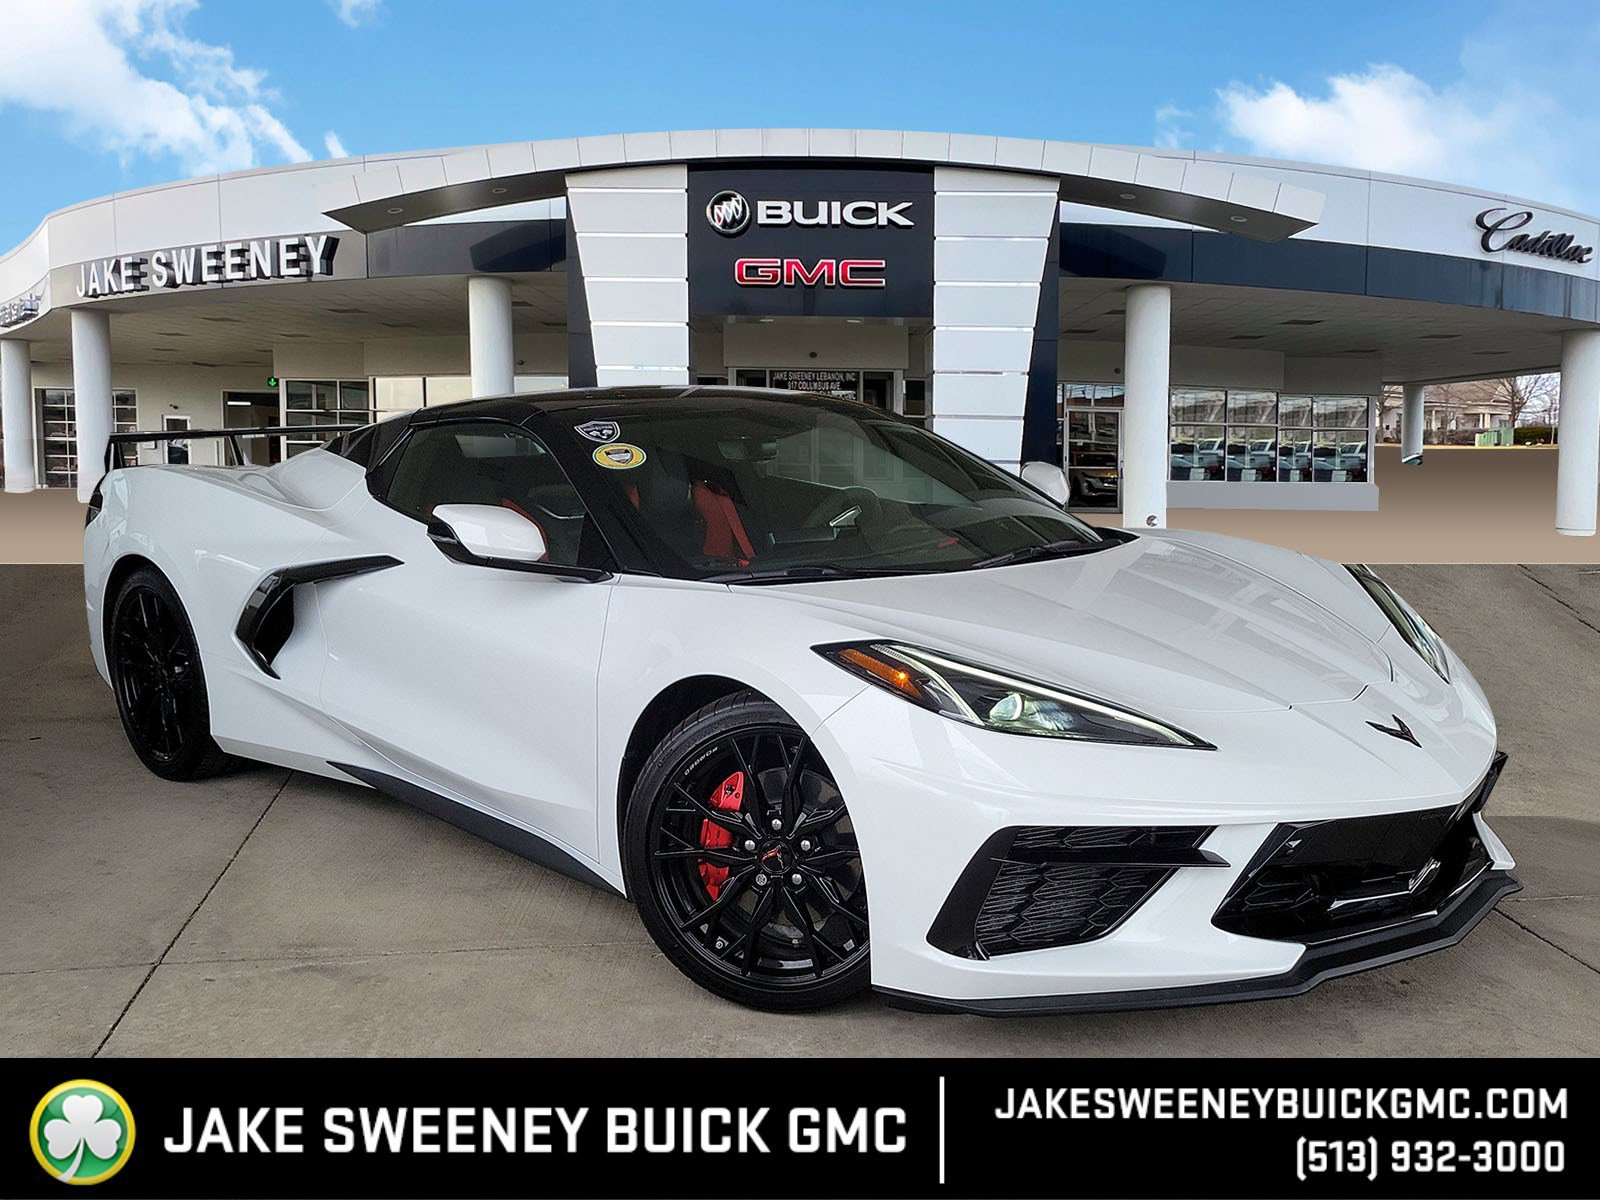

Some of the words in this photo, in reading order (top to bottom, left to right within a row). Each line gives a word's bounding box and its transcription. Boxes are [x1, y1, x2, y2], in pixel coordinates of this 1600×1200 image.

[757, 200, 915, 228] BUICK
[1475, 207, 1593, 264] Cadillac
[76, 255, 149, 299] JAKE
[151, 234, 339, 288] SWEENEY
[735, 258, 886, 287] GMC
